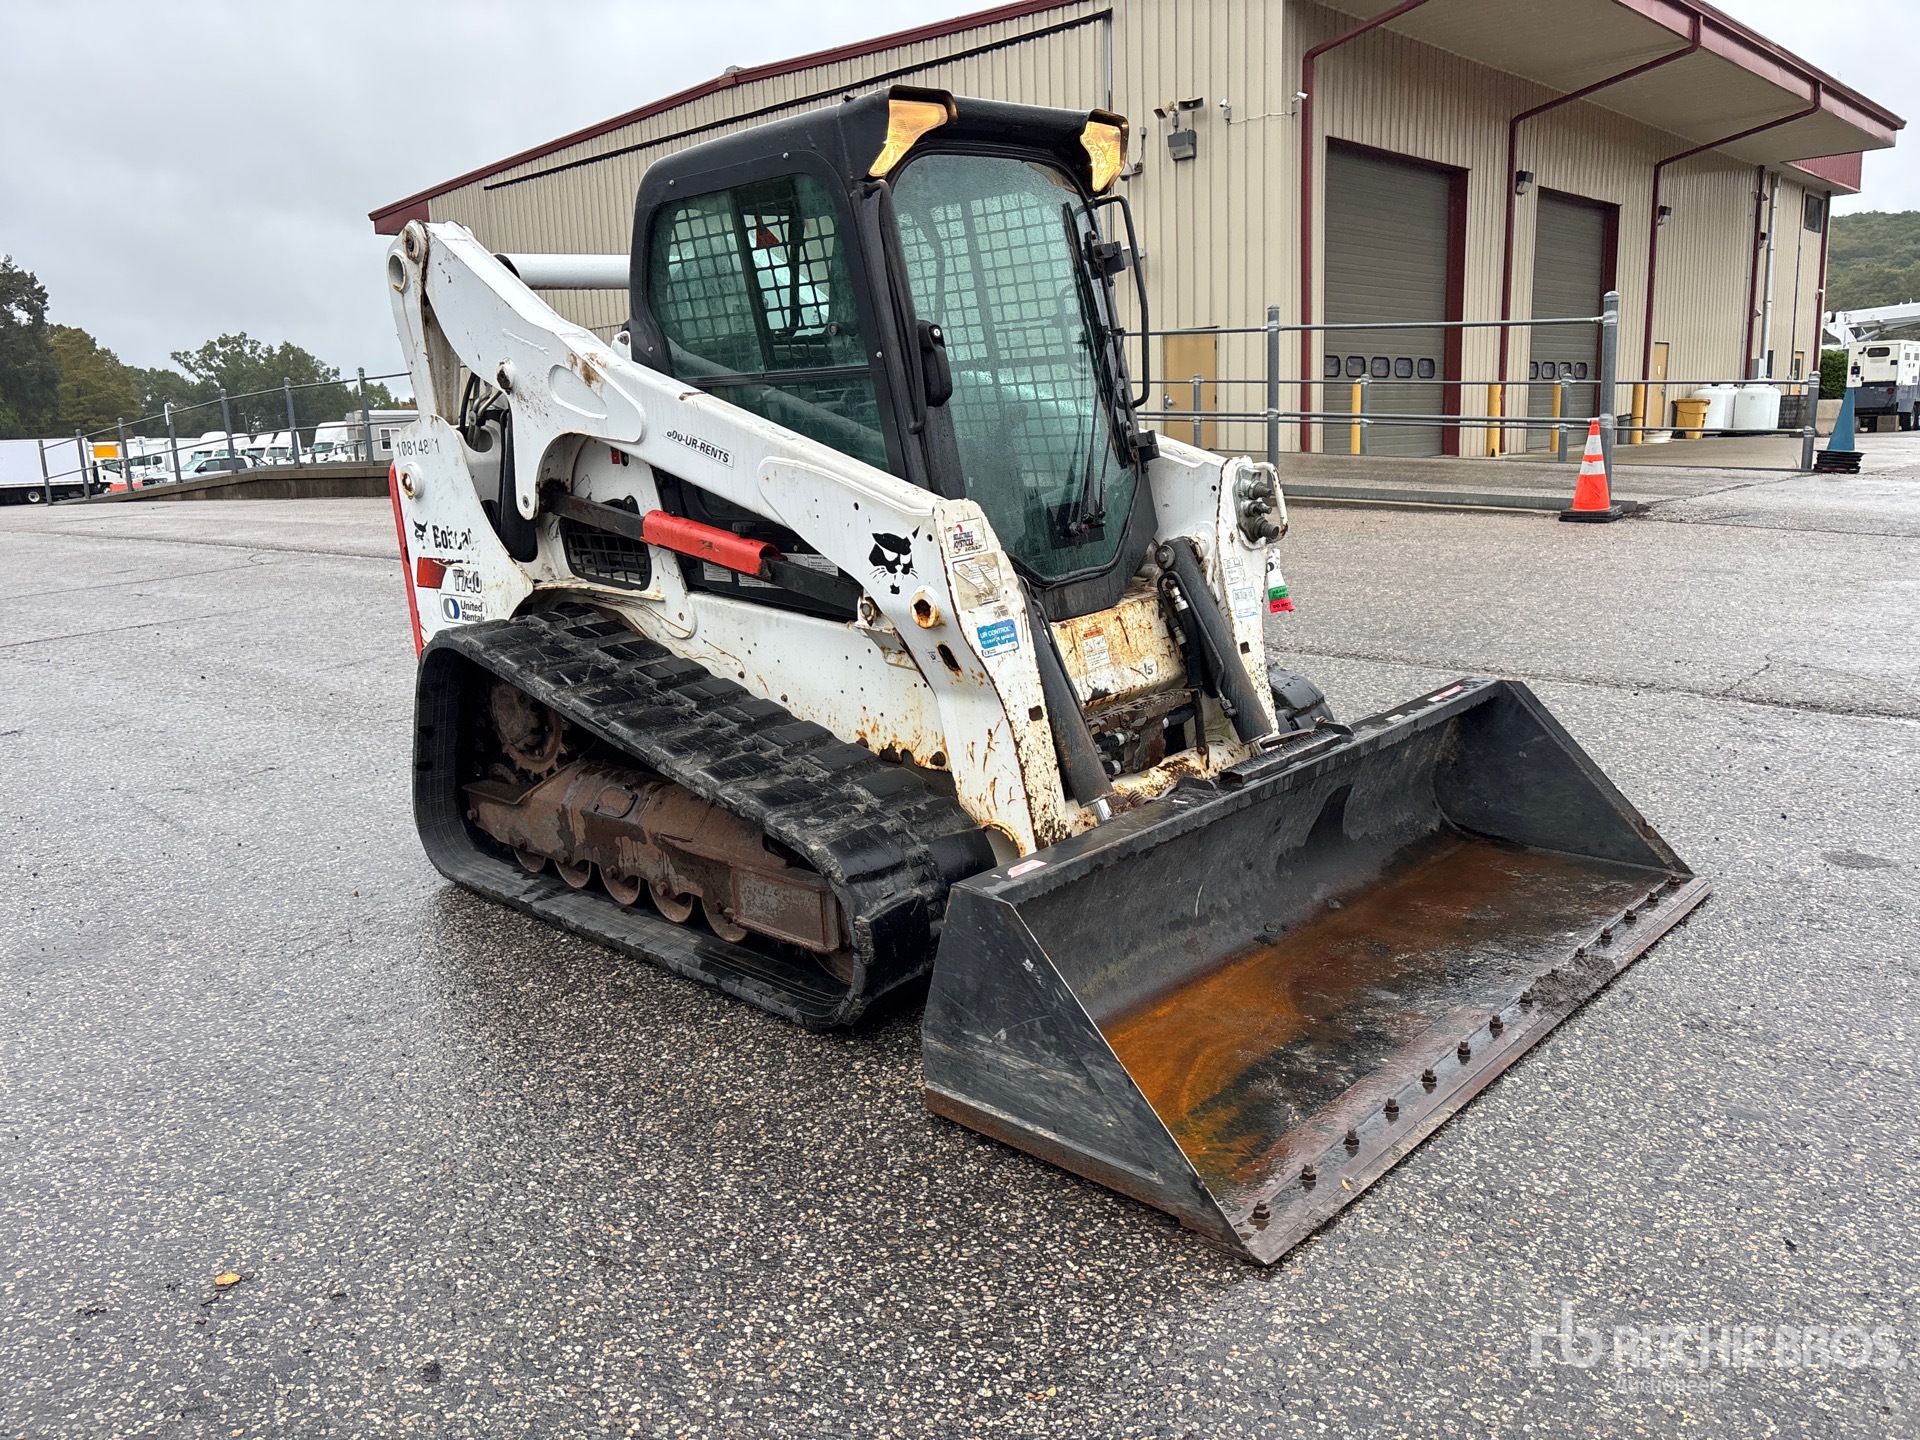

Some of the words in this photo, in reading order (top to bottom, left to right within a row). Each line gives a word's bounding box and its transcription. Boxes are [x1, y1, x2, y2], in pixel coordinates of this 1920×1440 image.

[396, 438, 440, 457] 1081481
[452, 569, 482, 594] T740
[460, 600, 483, 612] United
[987, 626, 1011, 637] CONTROL
